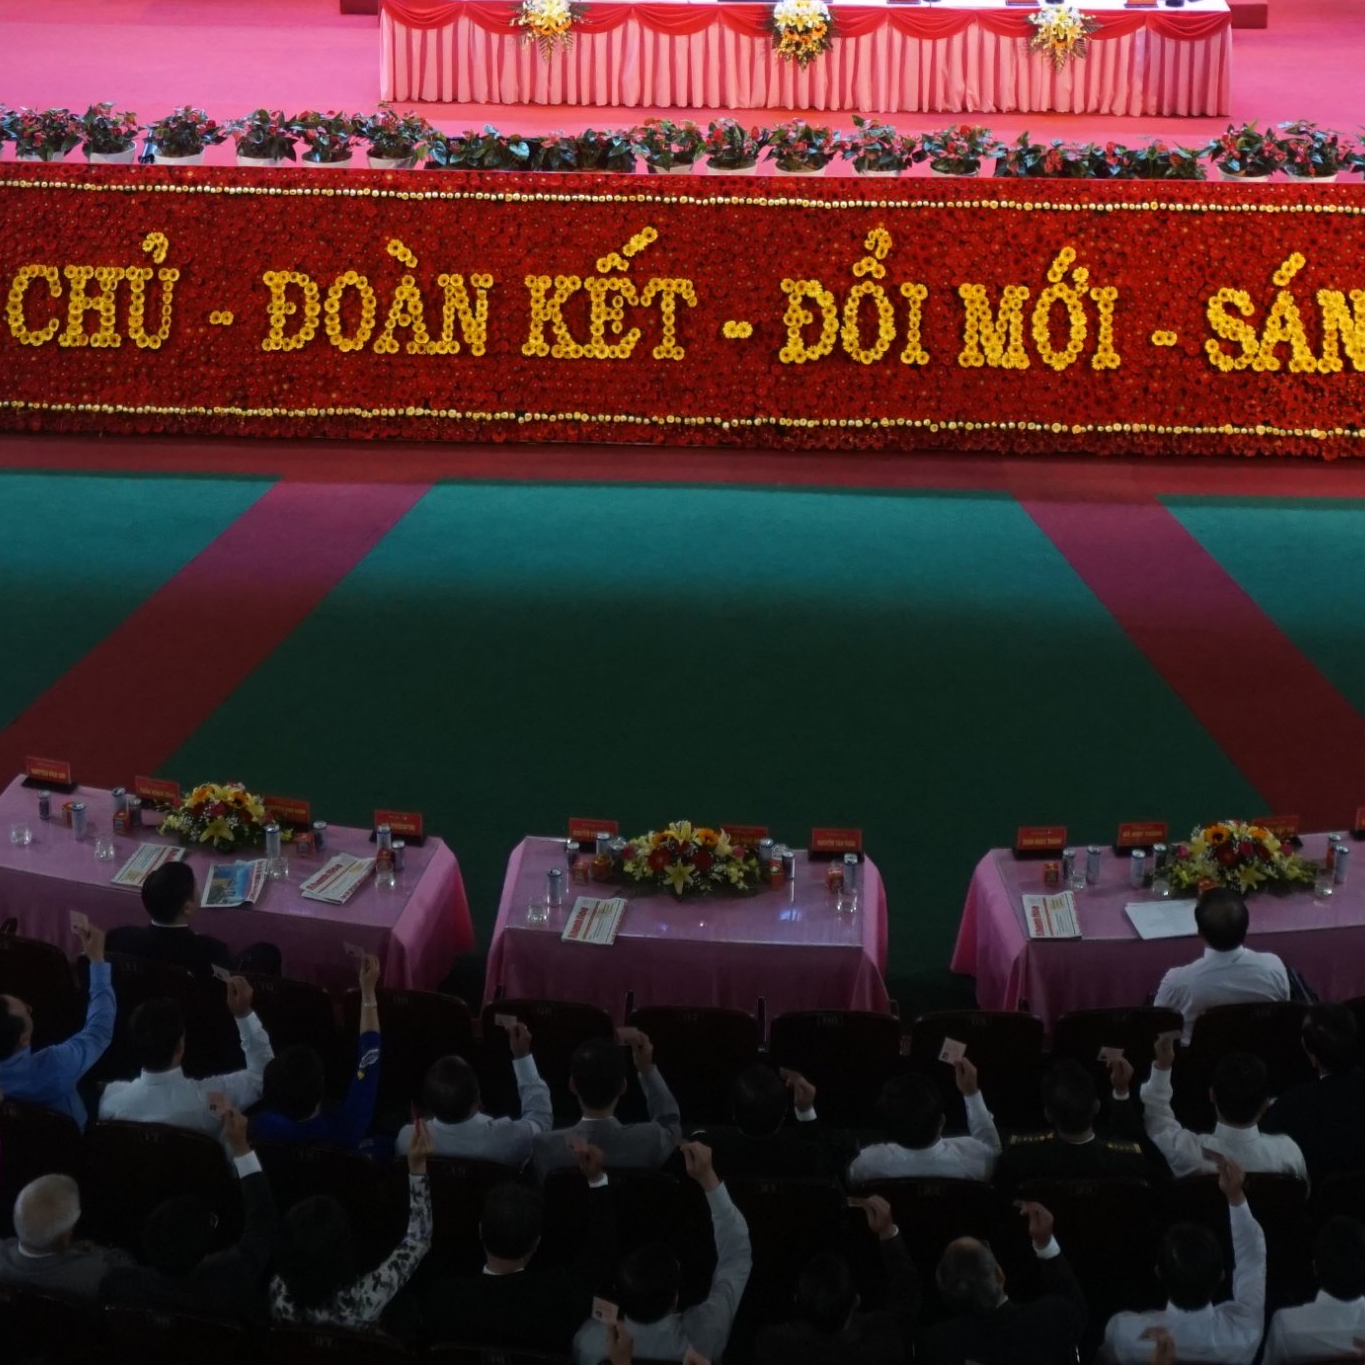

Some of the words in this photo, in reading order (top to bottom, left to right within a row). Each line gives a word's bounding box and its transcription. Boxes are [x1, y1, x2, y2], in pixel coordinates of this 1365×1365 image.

[6, 231, 180, 348] CHỦ
[261, 237, 493, 358] ĐOÀN
[521, 226, 698, 361] KẾT
[778, 223, 931, 366] ĐỔI
[957, 245, 1121, 371] MỚI
